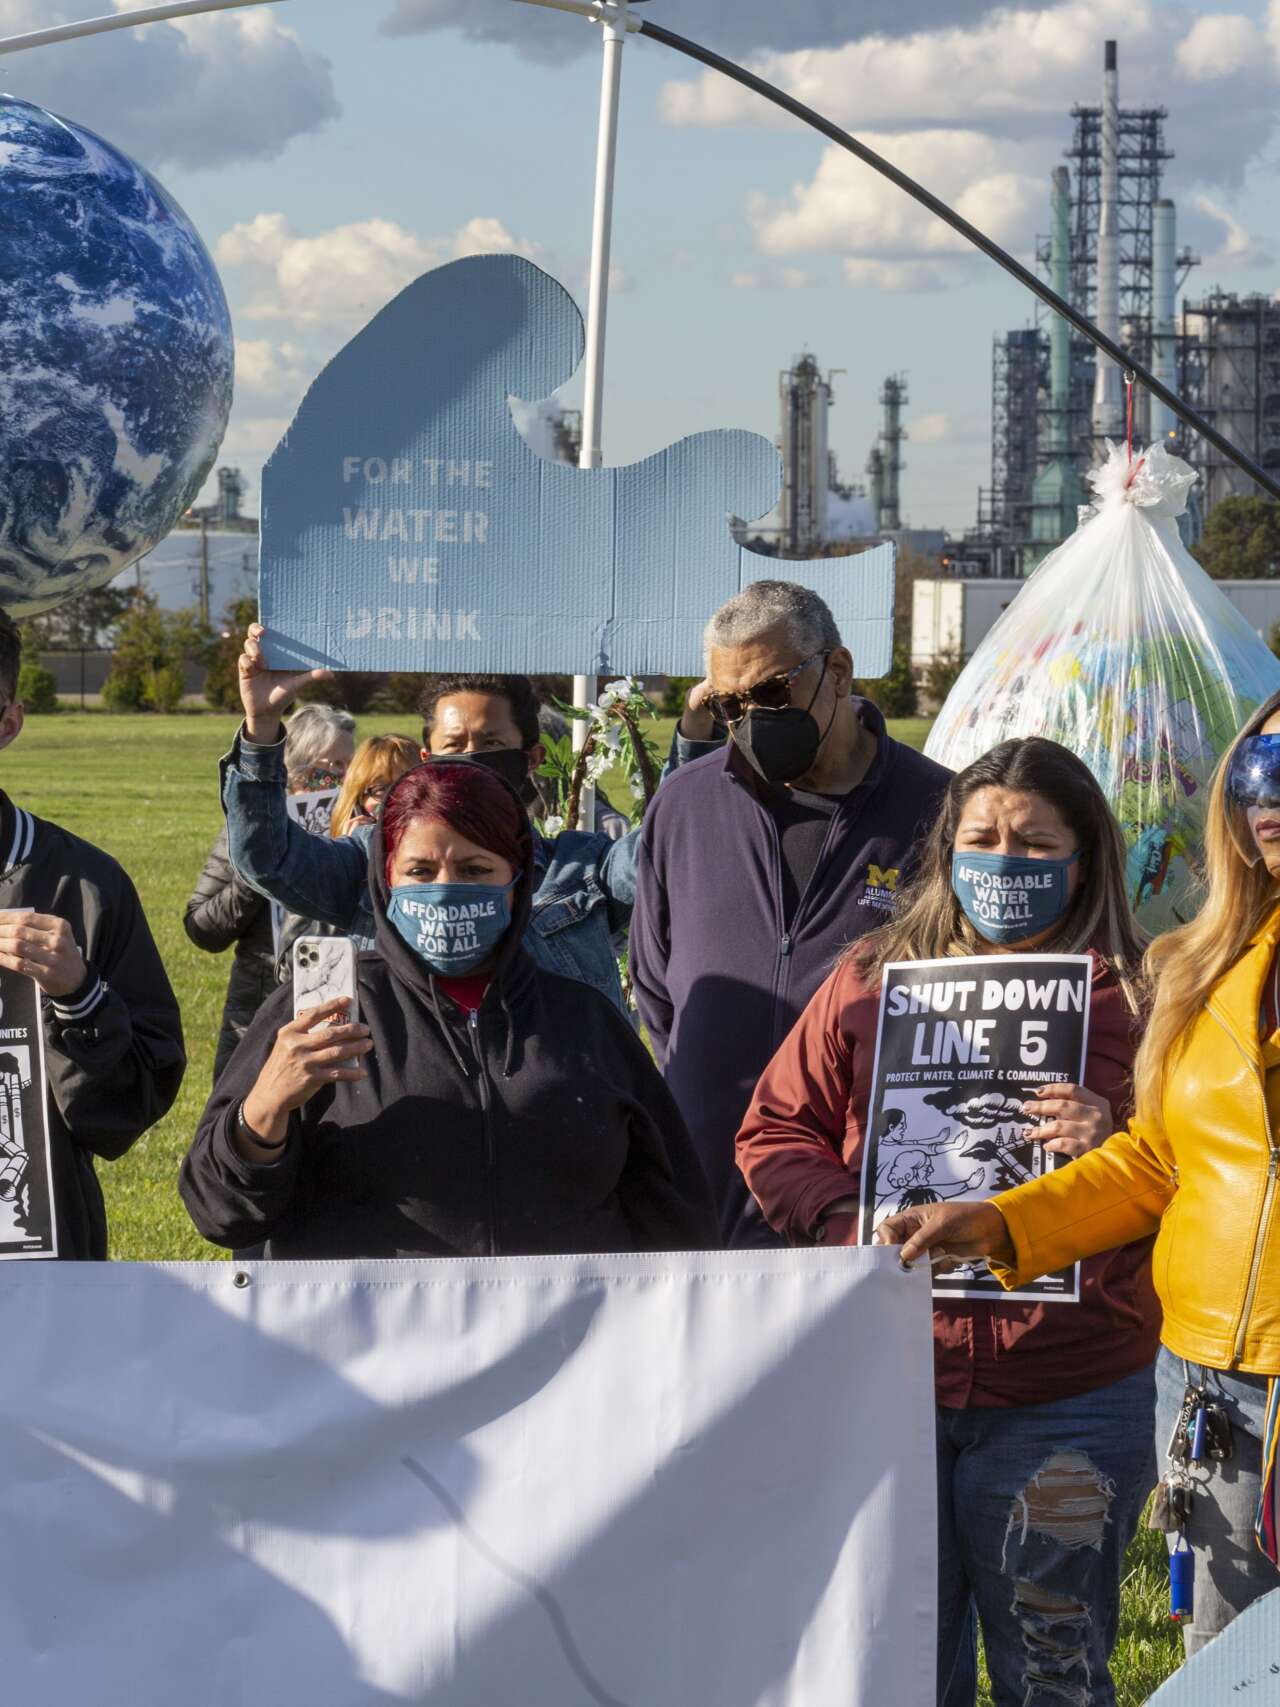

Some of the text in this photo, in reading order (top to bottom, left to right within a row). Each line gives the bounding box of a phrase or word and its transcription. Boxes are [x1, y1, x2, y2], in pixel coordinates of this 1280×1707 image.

[342, 456, 494, 488] FOR THE
[342, 507, 489, 544] WATER
[388, 557, 441, 584] WE
[345, 606, 482, 641] DRINK
[866, 864, 899, 890] M
[959, 866, 1053, 889] AFFORDABLE
[974, 886, 1029, 904] WATER
[402, 899, 496, 921] AFFORDABLE
[972, 900, 1033, 920] FOR ALL
[421, 920, 476, 937] WATER
[417, 934, 480, 953] FOR ALL
[887, 979, 1083, 1017] SHUT DOWN
[911, 1019, 1048, 1066] LINE 5
[886, 1072, 920, 1082] PROTECT
[958, 1070, 995, 1080] CLIMATE
[997, 1070, 1003, 1080] &
[1006, 1071, 1069, 1083] COMMUNITIES
